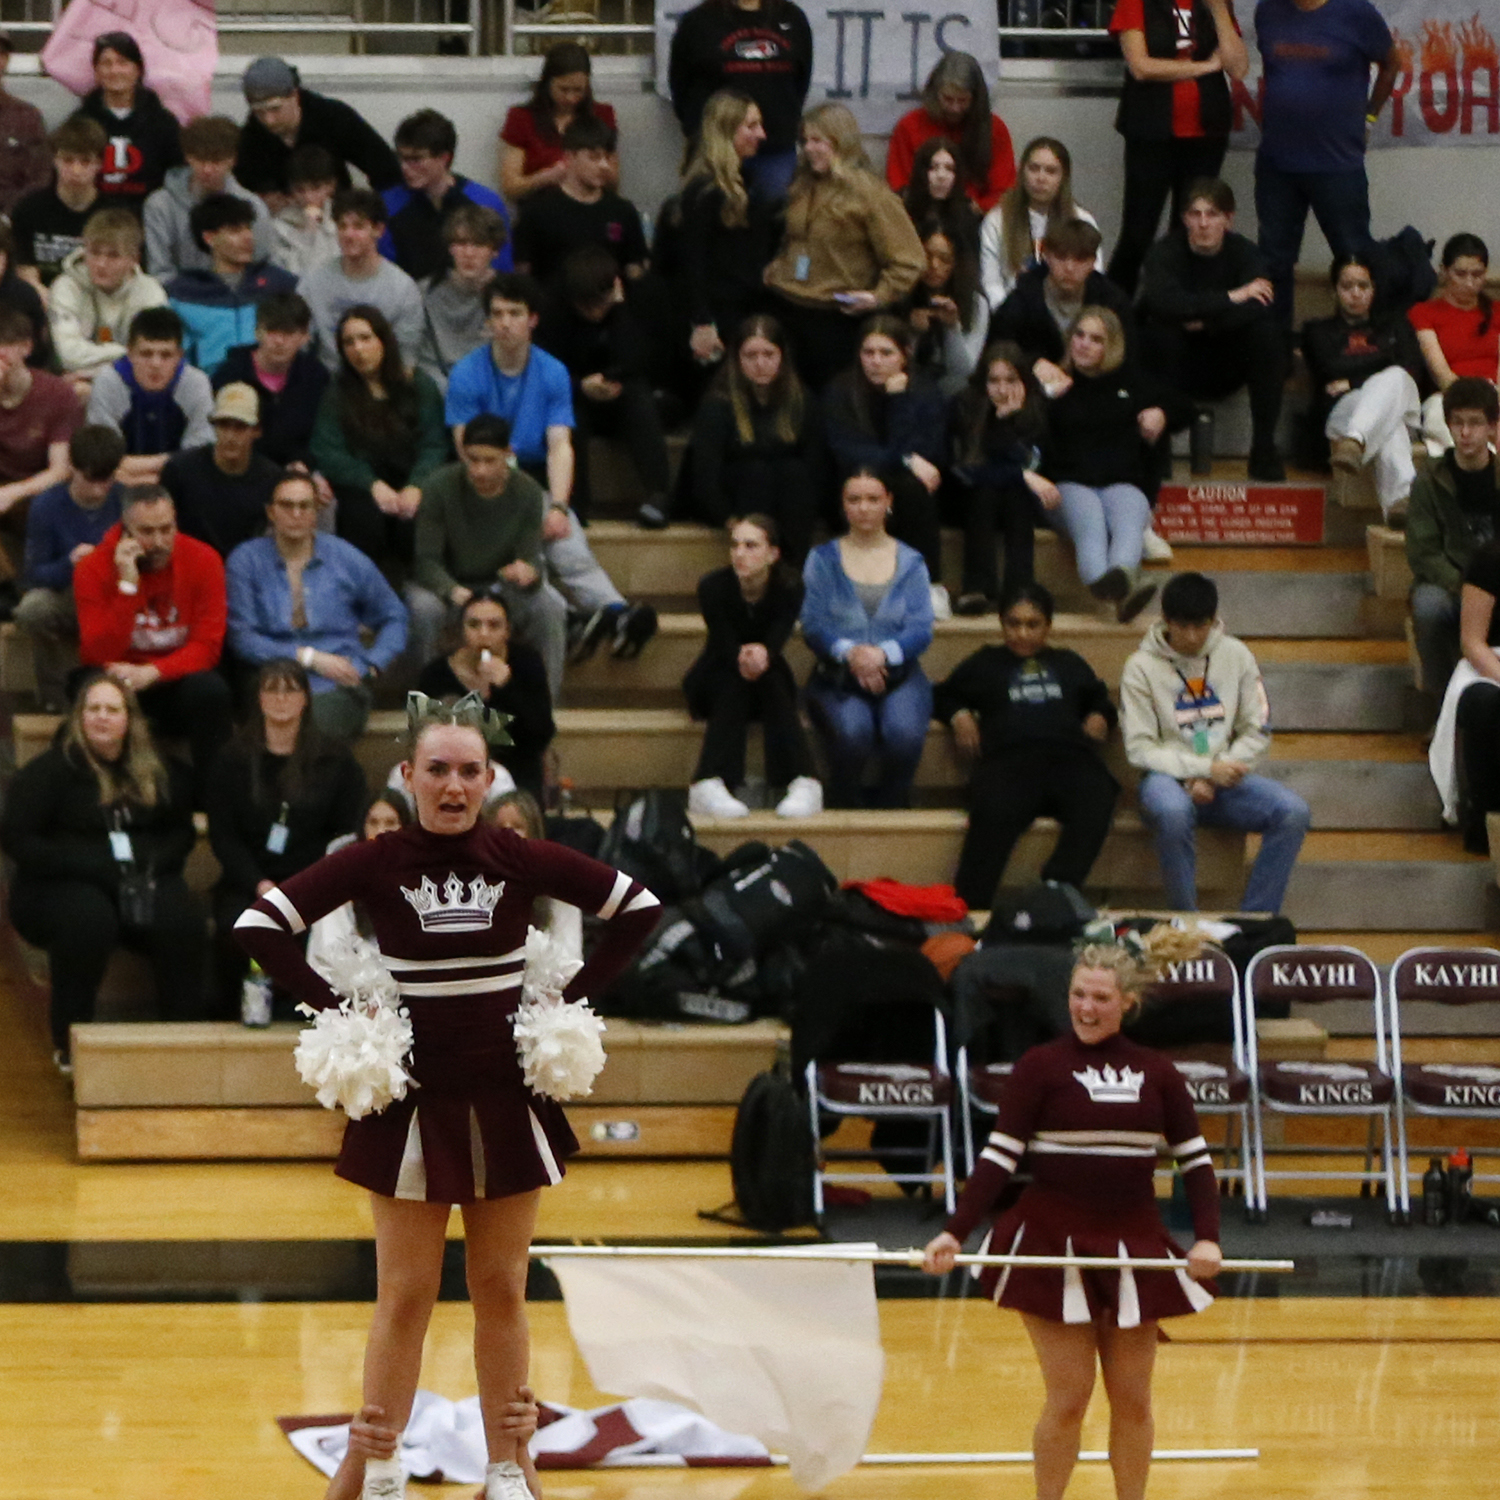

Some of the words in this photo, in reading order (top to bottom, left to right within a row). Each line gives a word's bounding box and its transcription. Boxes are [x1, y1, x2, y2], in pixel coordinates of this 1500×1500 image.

[826, 10, 885, 98] IT
[1187, 486, 1247, 502] CAUTION
[1156, 959, 1216, 983] YHI
[1271, 963, 1356, 987] KAYHI
[1414, 963, 1499, 986] KAYHI
[859, 1083, 934, 1103] KINGS
[1185, 1083, 1229, 1102] NGS
[1299, 1083, 1373, 1103] KINGS
[1444, 1085, 1500, 1104] KING
